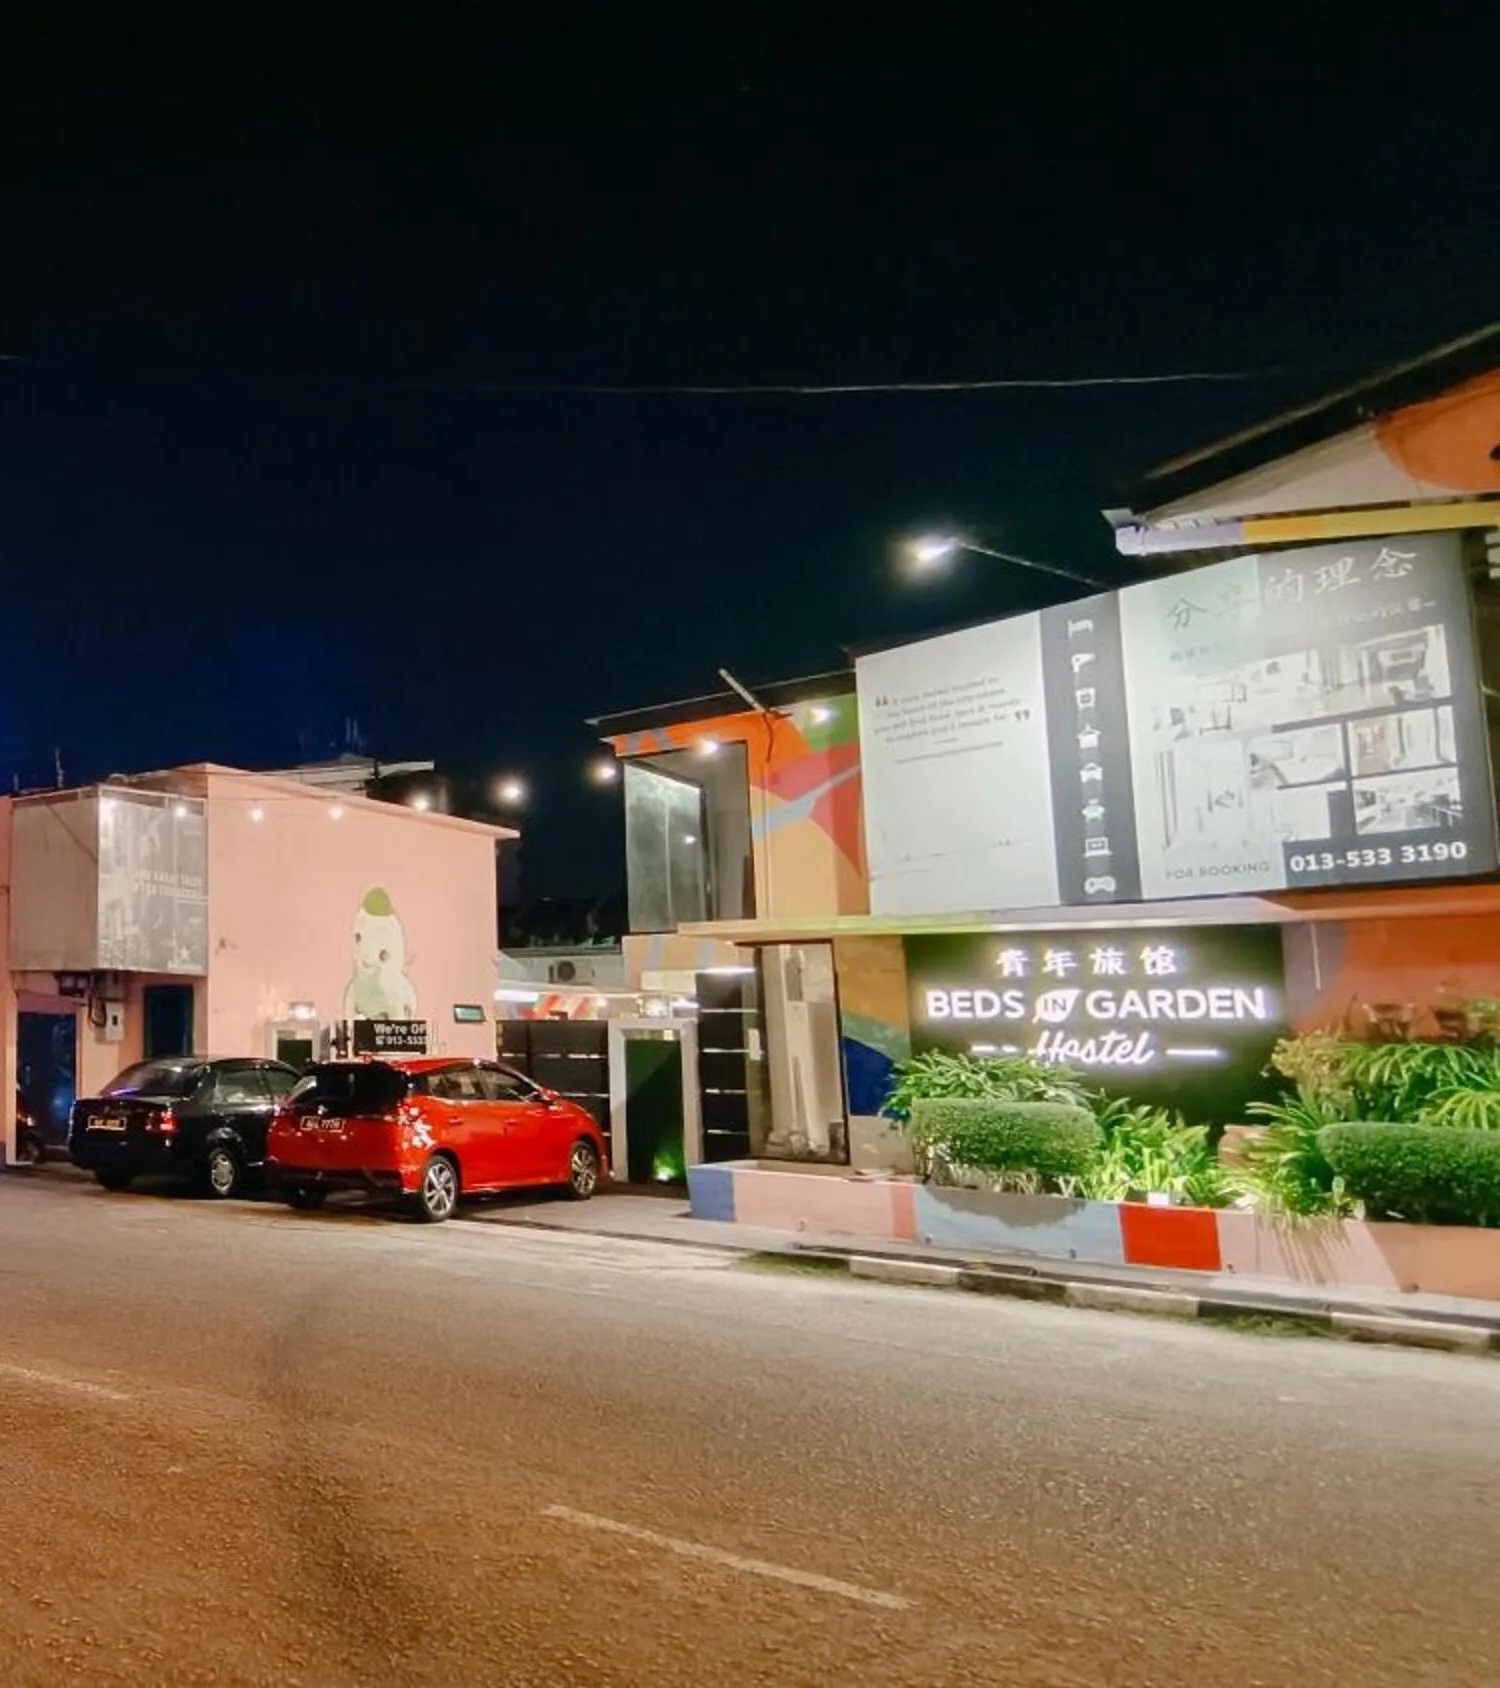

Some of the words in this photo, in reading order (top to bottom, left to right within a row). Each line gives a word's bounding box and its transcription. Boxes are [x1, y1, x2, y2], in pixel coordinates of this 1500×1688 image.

[1165, 867, 1194, 880] FOR
[1198, 861, 1270, 878] BOOKING
[1289, 848, 1392, 873] 013-533
[1400, 841, 1468, 865] 3190
[996, 946, 1177, 977] 青年旅馆
[926, 989, 1026, 1019] BEDS
[1043, 998, 1067, 1011] IN
[1085, 986, 1268, 1019] GARDEN
[374, 1024, 407, 1035] We're
[1028, 1029, 1155, 1065] Hostel
